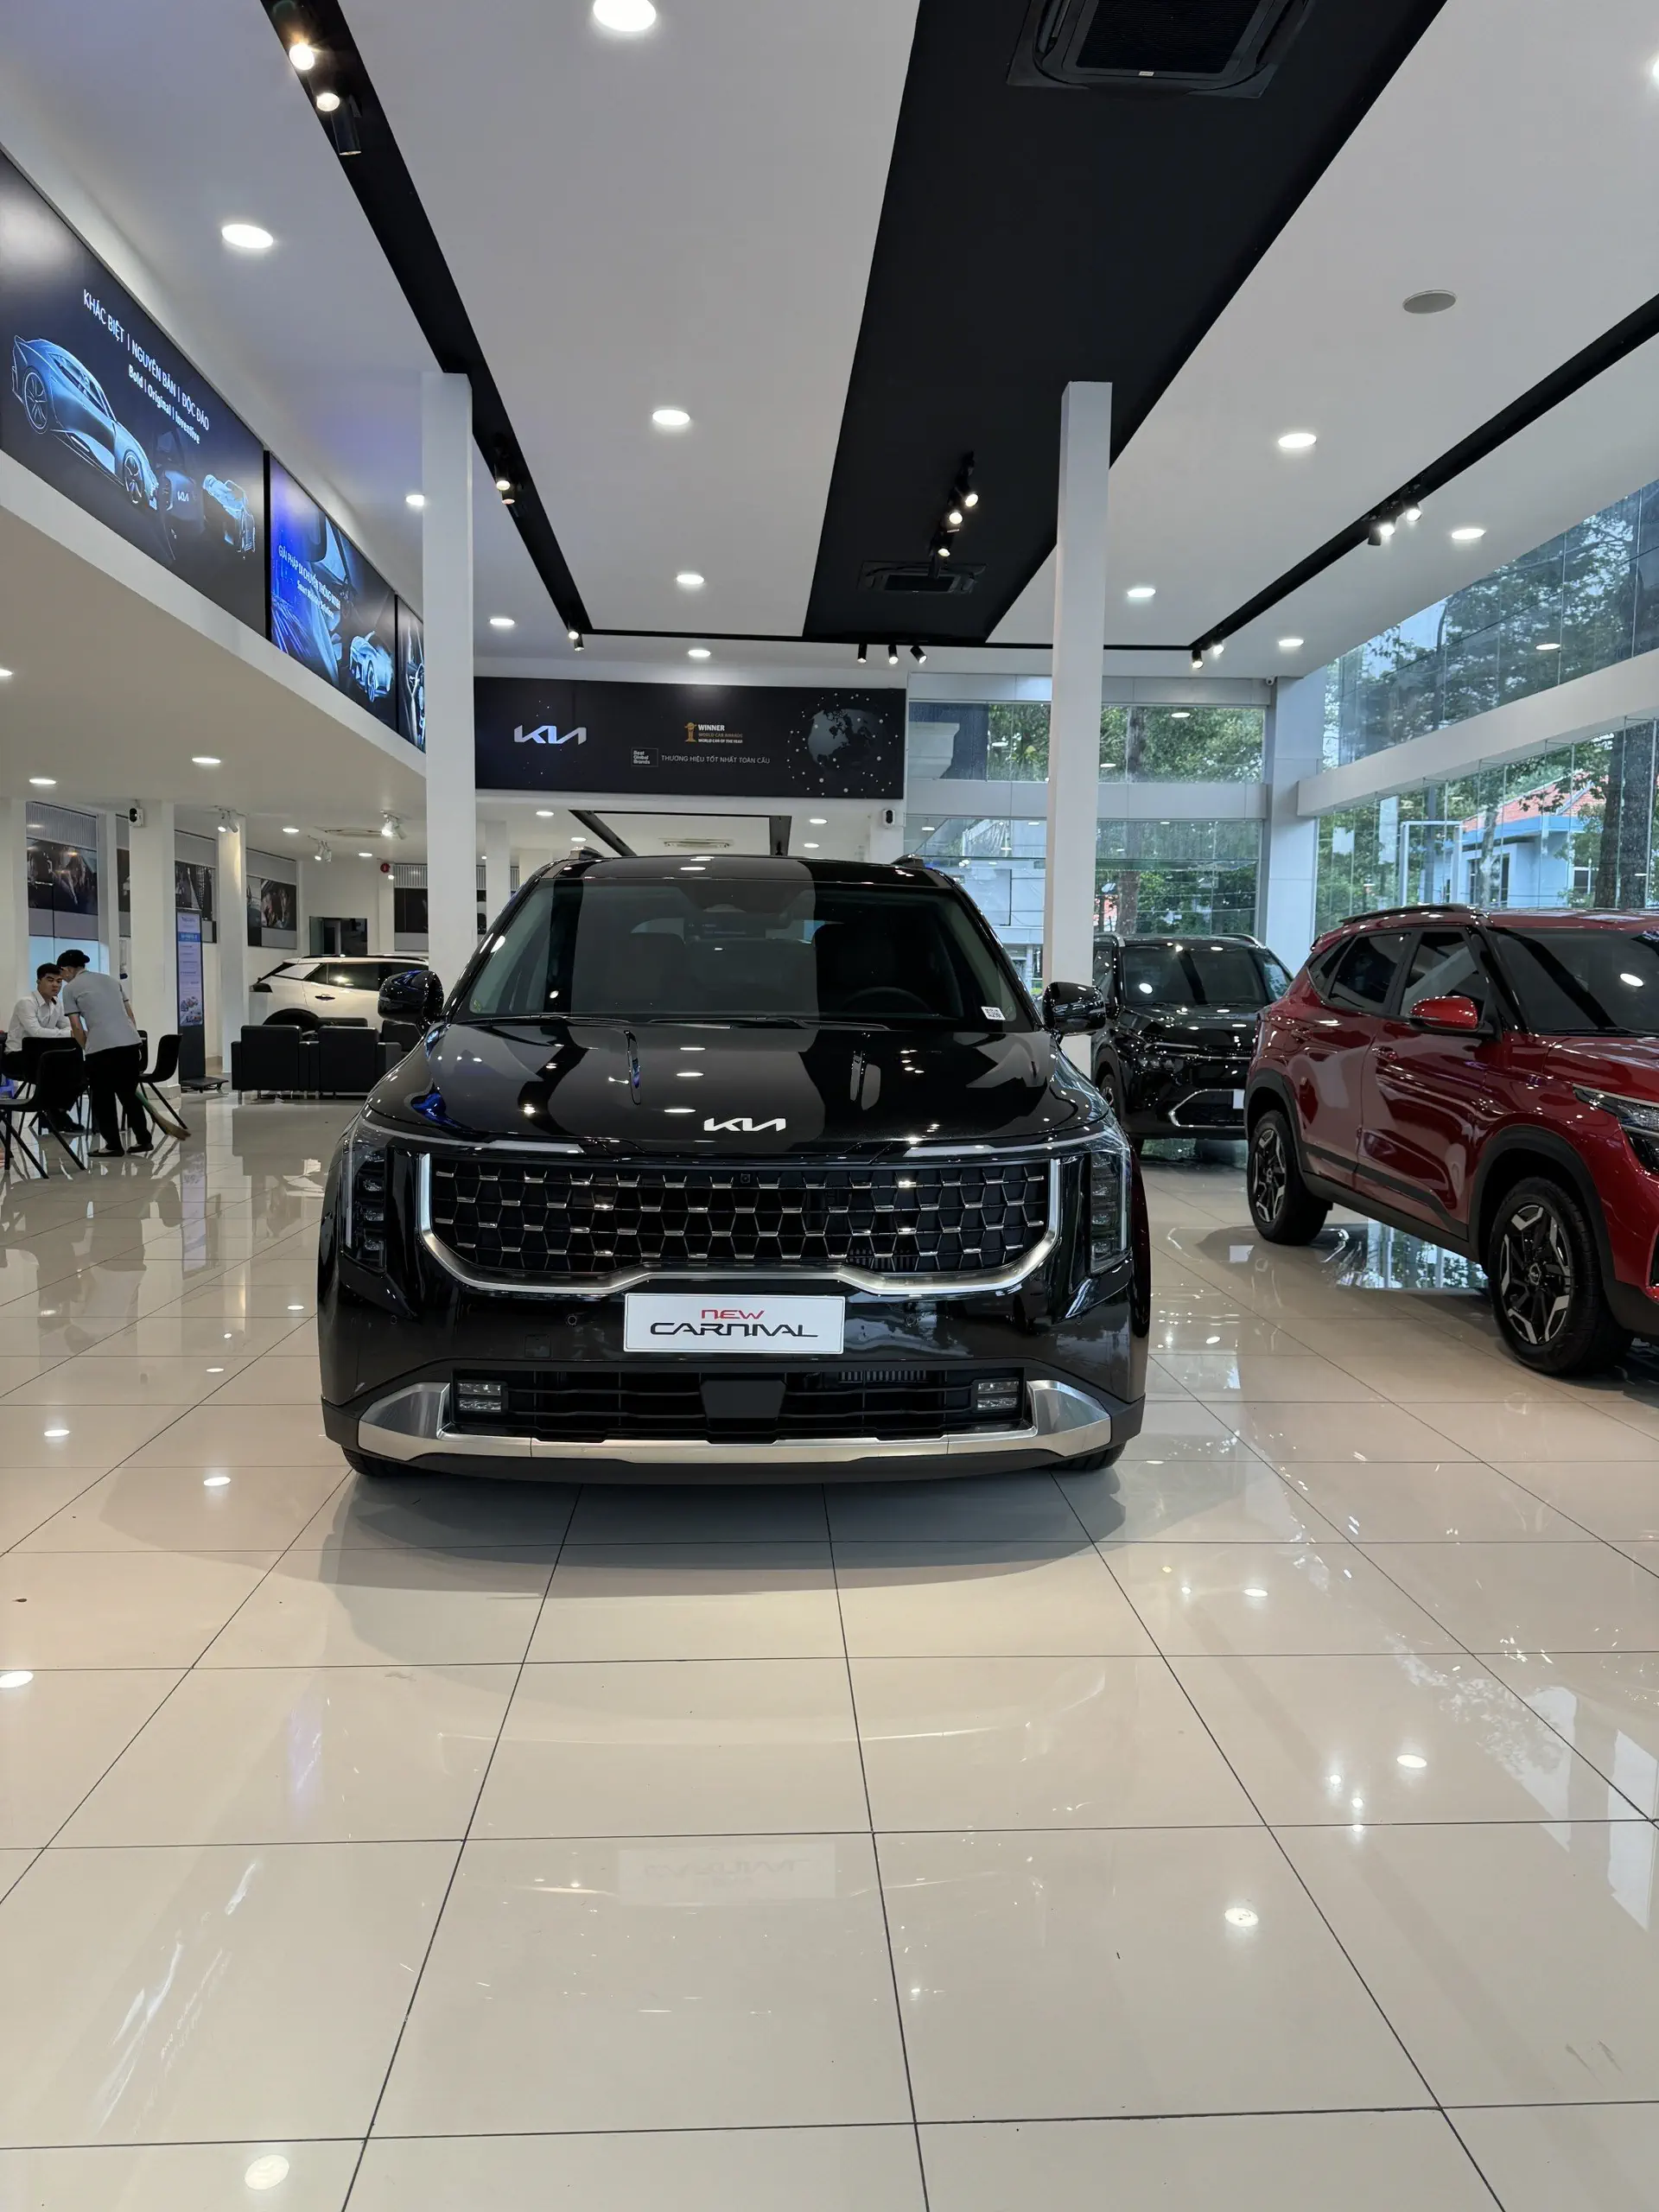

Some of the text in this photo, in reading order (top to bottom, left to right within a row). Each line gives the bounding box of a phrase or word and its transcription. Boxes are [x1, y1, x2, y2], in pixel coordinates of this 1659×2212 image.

[84, 289, 106, 325] KHÁC
[108, 314, 124, 343] BIỆT
[131, 340, 162, 382] NGUYÊN
[181, 391, 196, 417] ĐỘC
[196, 406, 210, 430] ĐÁO
[129, 364, 143, 389] Bold
[147, 384, 172, 416] Original
[175, 410, 200, 444] Inventive
[514, 725, 587, 745] KIA
[703, 1117, 786, 1132] KIA
[701, 1309, 765, 1319] NEW
[650, 1322, 819, 1338] CARNIVAL
